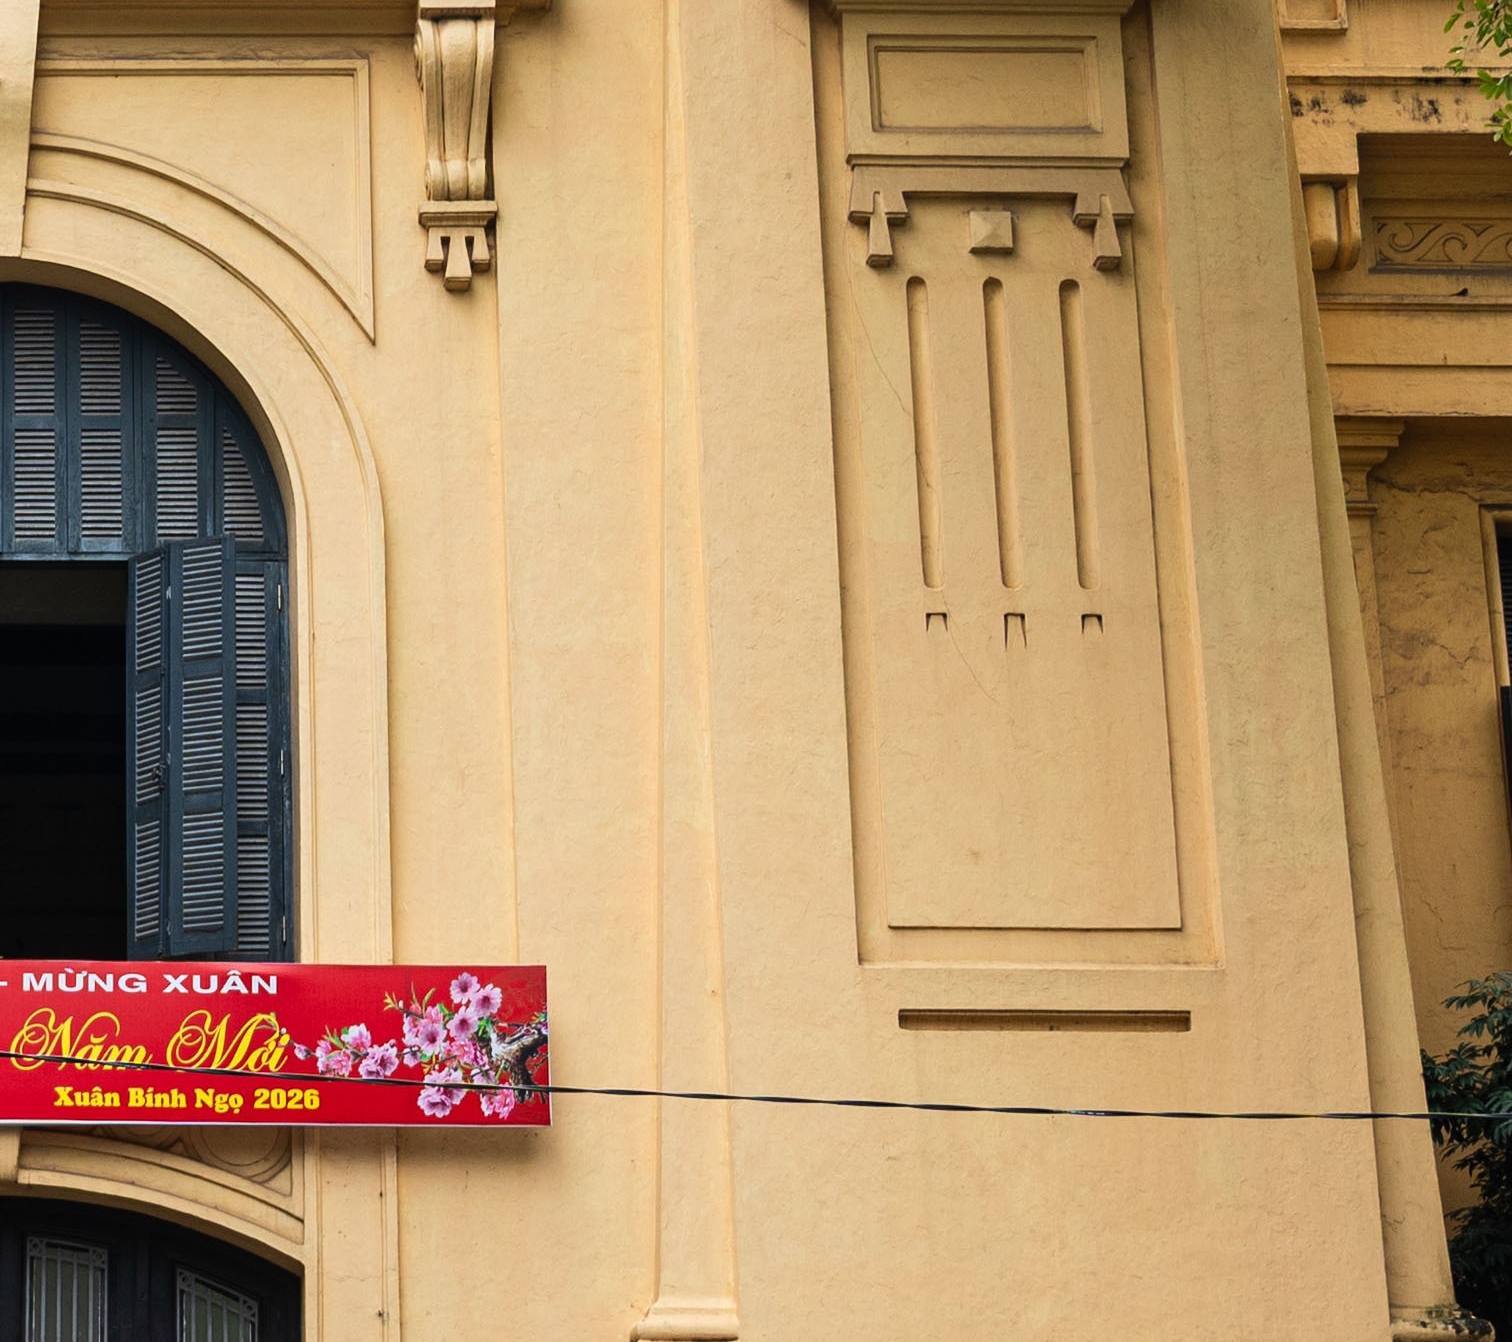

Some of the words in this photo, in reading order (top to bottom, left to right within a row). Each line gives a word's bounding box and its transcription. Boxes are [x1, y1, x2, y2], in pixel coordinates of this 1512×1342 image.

[22, 967, 147, 993] MỪNG
[162, 969, 278, 995] XUÂN
[9, 1007, 153, 1071] Năm
[165, 1009, 290, 1073] Mới
[54, 1086, 121, 1107] Xuân
[127, 1086, 187, 1108] Bính
[194, 1088, 244, 1114] Ngọ
[253, 1088, 320, 1109] 2026
